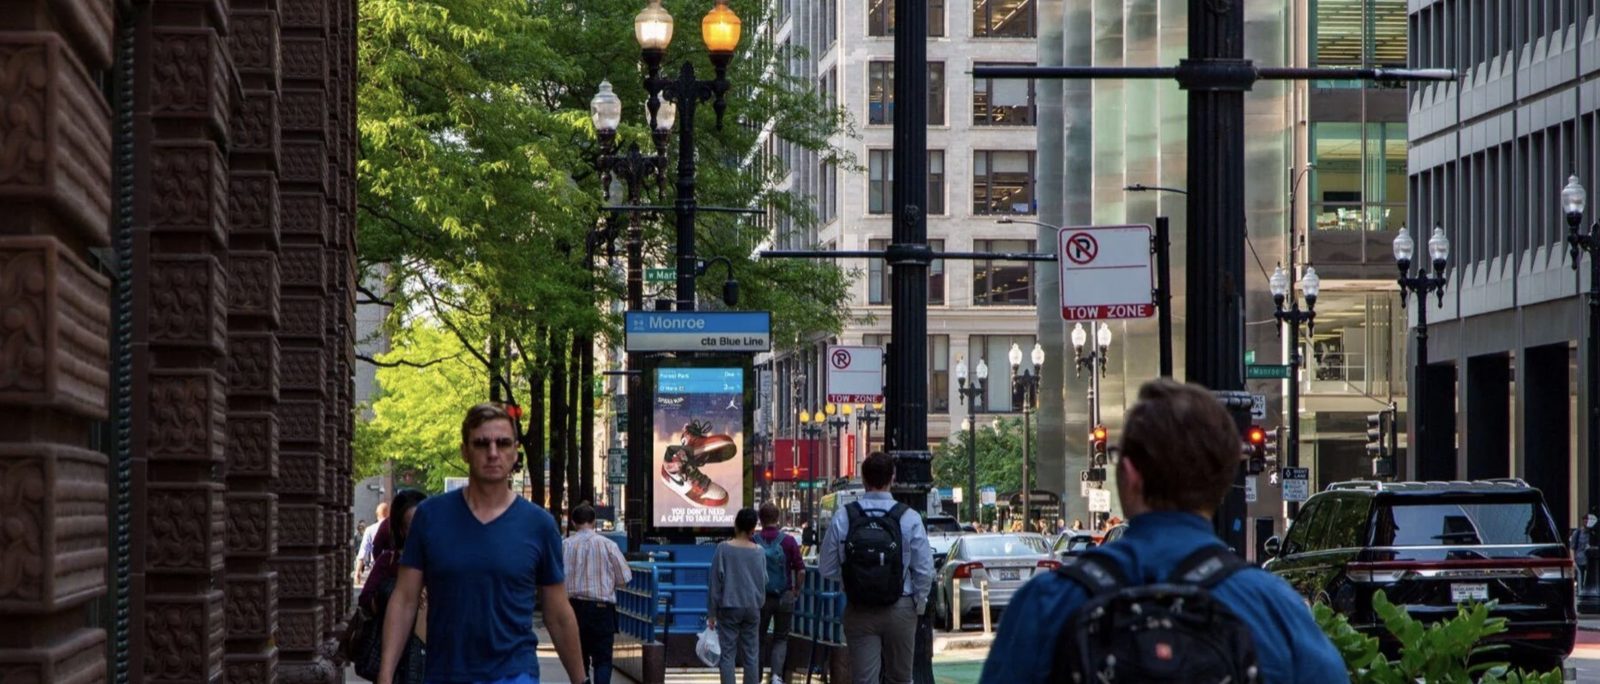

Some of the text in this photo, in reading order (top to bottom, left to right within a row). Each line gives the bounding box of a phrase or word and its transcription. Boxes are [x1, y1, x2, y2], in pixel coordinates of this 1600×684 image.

[1068, 304, 1146, 319] TOW ZONE
[650, 316, 705, 329] Monroe
[701, 337, 764, 346] cta Blue Line
